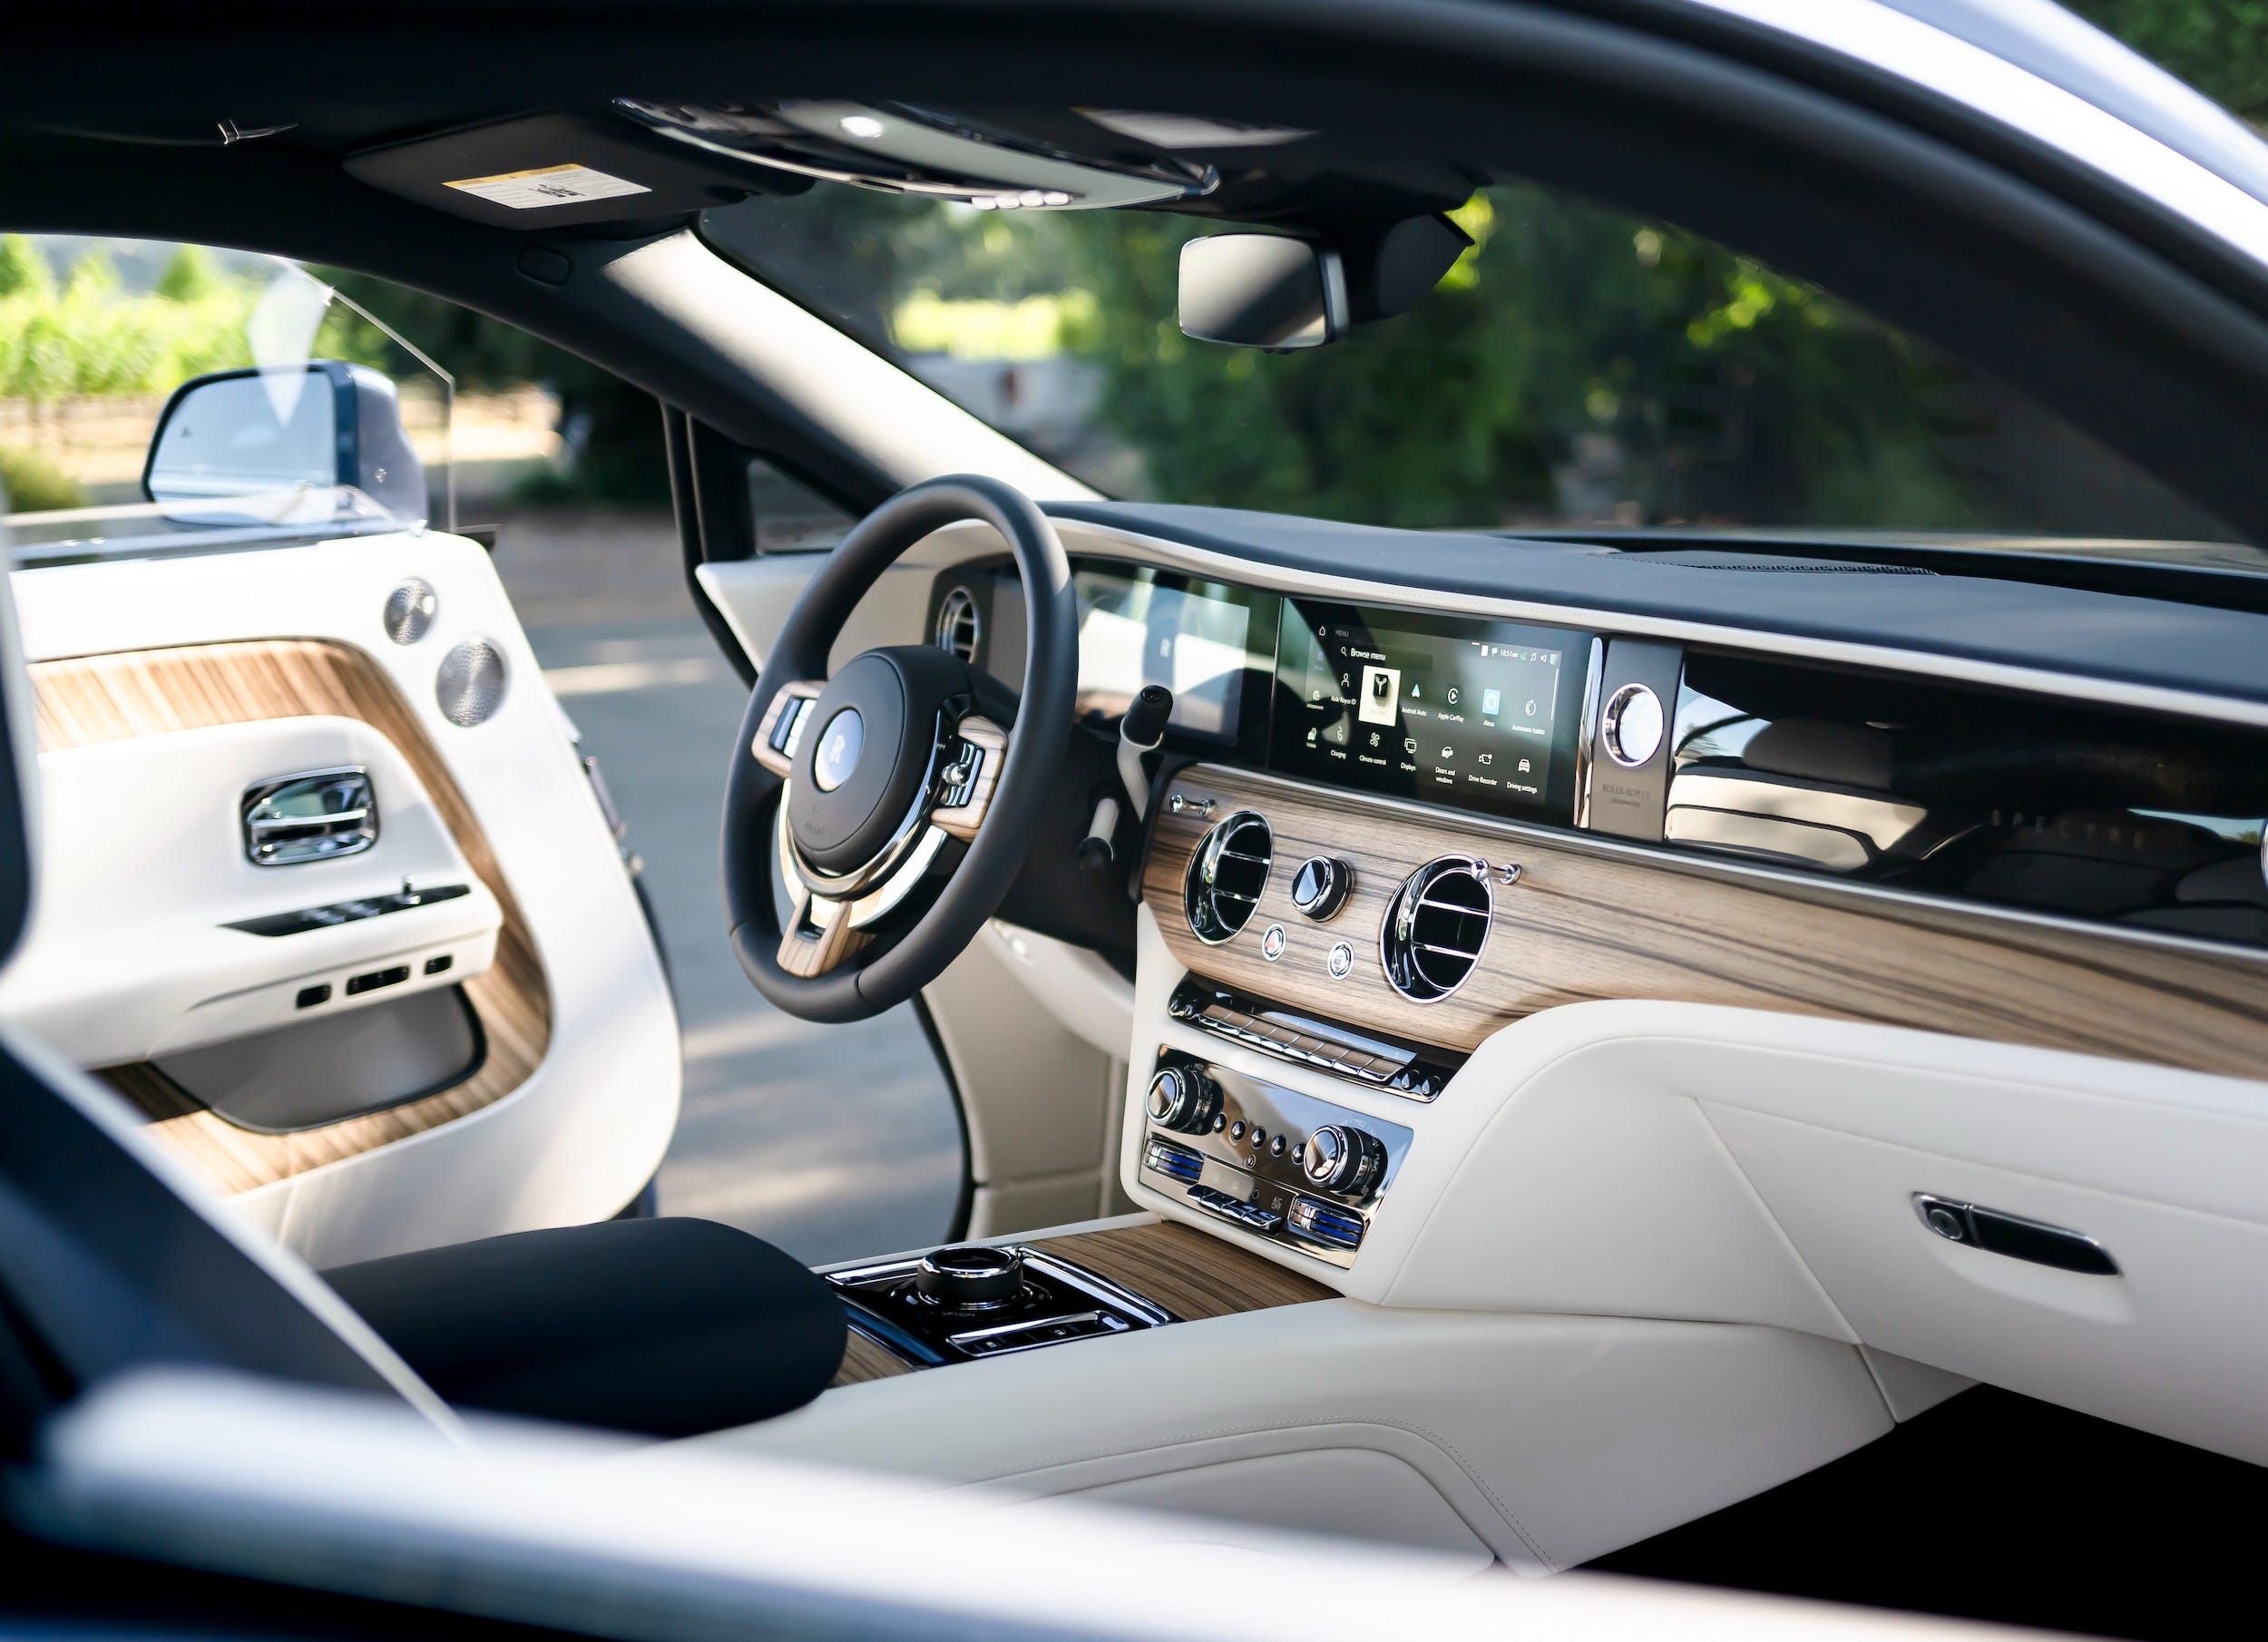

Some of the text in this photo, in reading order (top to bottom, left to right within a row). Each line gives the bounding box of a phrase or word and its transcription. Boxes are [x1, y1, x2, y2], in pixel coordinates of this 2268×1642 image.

[1350, 648, 1386, 661] Browse menu
[1401, 707, 1427, 717] Android Auto
[1437, 712, 1464, 723] Apple CarPlay
[1400, 762, 1416, 772] Displays
[1435, 767, 1447, 776] Doors
[1435, 776, 1453, 785] windows
[1468, 774, 1498, 787] Drive Recorder
[1506, 781, 1538, 795] Driving settings
